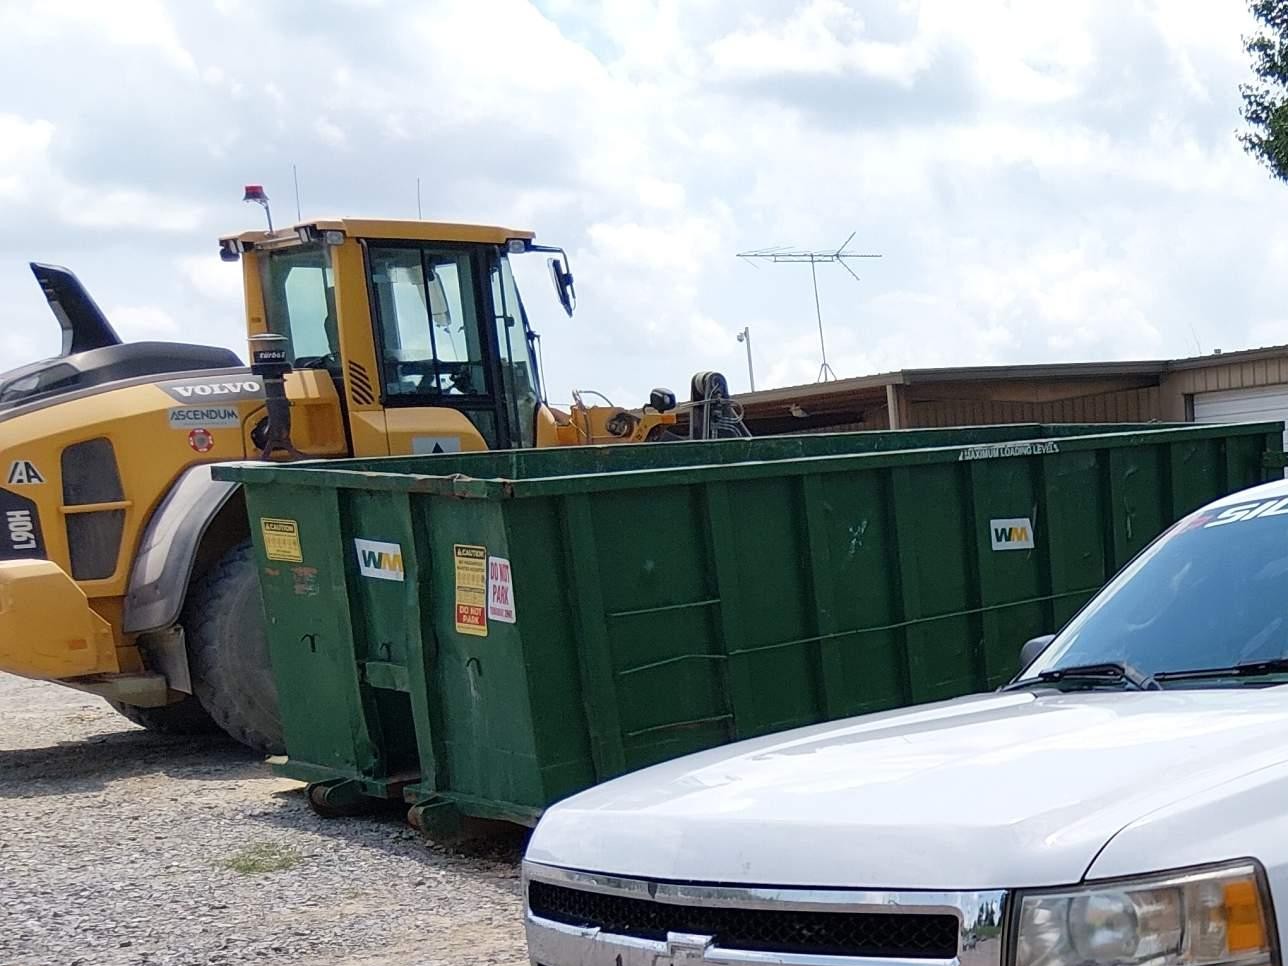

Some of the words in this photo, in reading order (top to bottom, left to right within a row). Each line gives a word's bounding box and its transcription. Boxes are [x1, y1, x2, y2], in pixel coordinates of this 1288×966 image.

[172, 381, 261, 397] VOLVO
[170, 409, 238, 421] ASCENDUM
[964, 446, 999, 460] MAXIMUM
[1000, 443, 1032, 457] LOADING
[6, 510, 37, 550] L90H
[994, 527, 1029, 543] WM
[361, 549, 403, 573] WM
[462, 548, 485, 558] CAUTION
[490, 562, 499, 581] DO
[499, 563, 510, 584] NOT
[492, 584, 509, 605] PARK
[459, 605, 469, 614] DO
[470, 607, 482, 616] NOT
[462, 614, 480, 625] PARK
